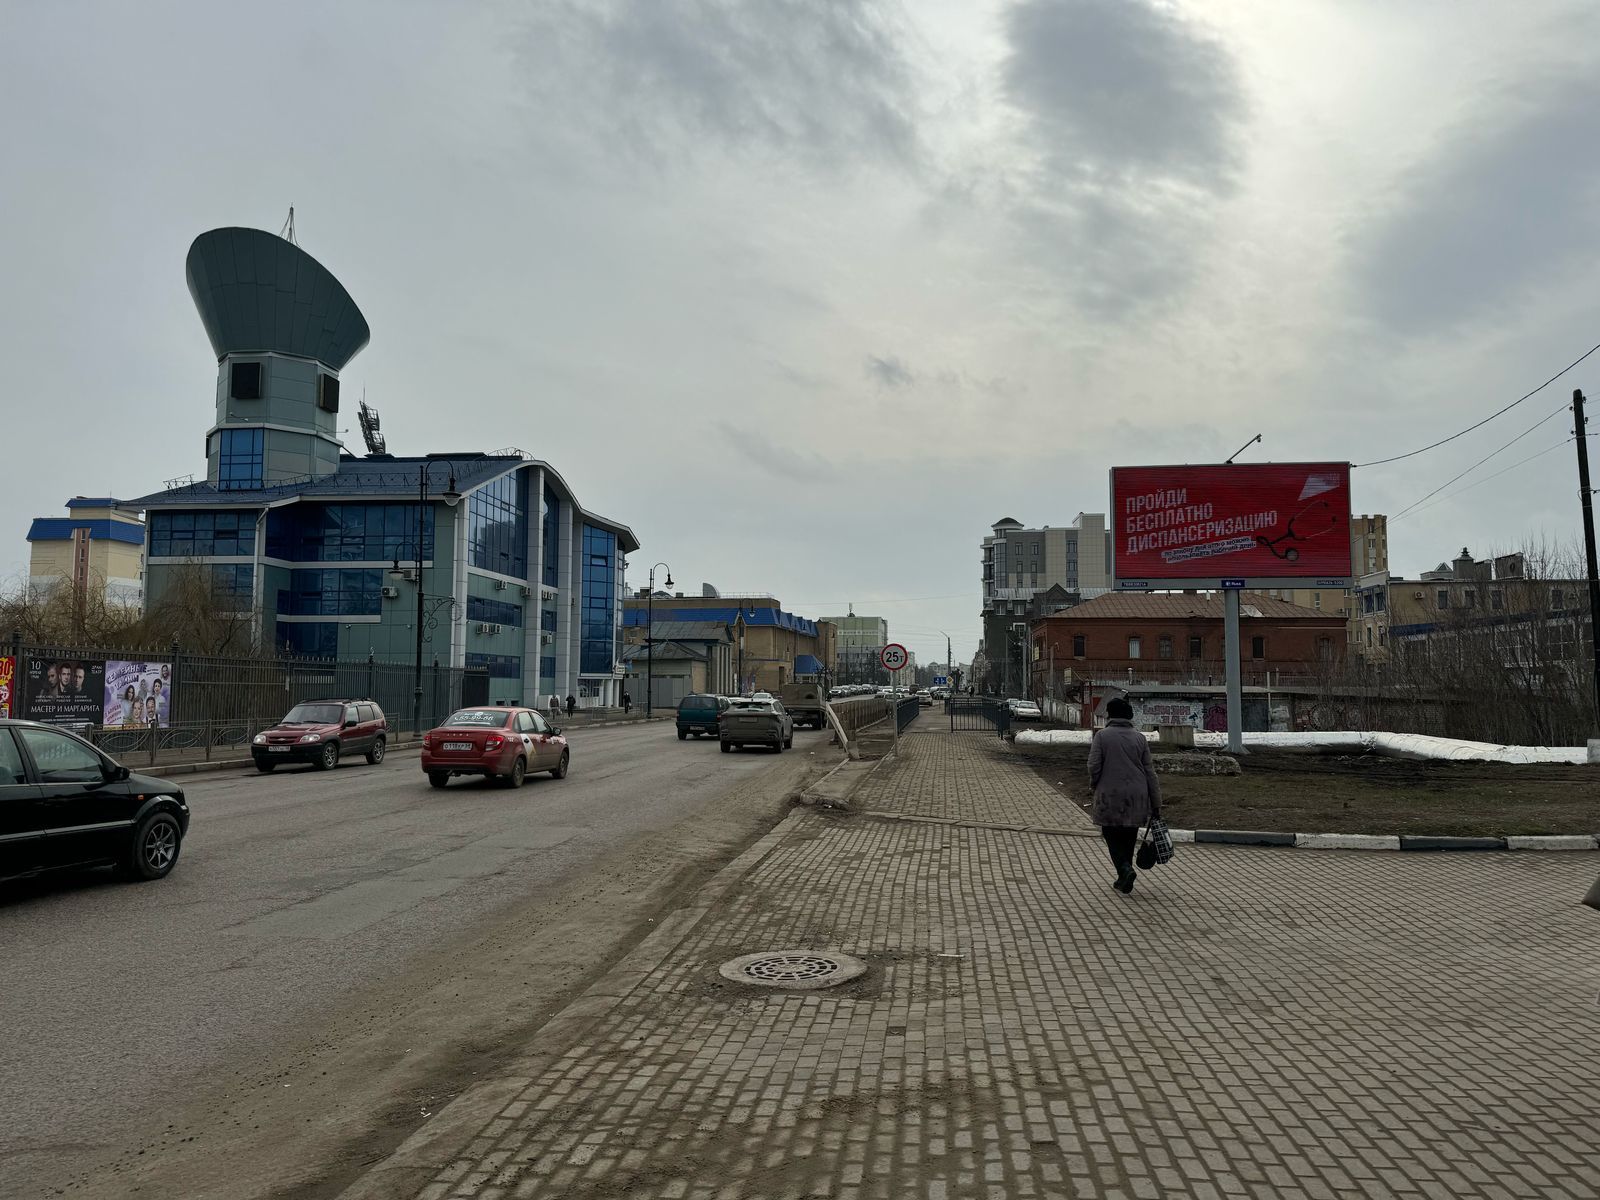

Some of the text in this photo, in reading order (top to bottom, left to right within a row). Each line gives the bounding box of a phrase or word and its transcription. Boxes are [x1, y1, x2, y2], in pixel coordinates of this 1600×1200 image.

[1126, 488, 1187, 514] ПРОЙДИ
[1126, 502, 1213, 533] БЕСПЛАТНО
[1126, 510, 1278, 555] ДИСПАНСЕРИЗАЦИЮ
[31, 661, 41, 670] 10
[31, 705, 55, 713] МАСТЕР
[64, 704, 100, 712] МАРГАРИТА
